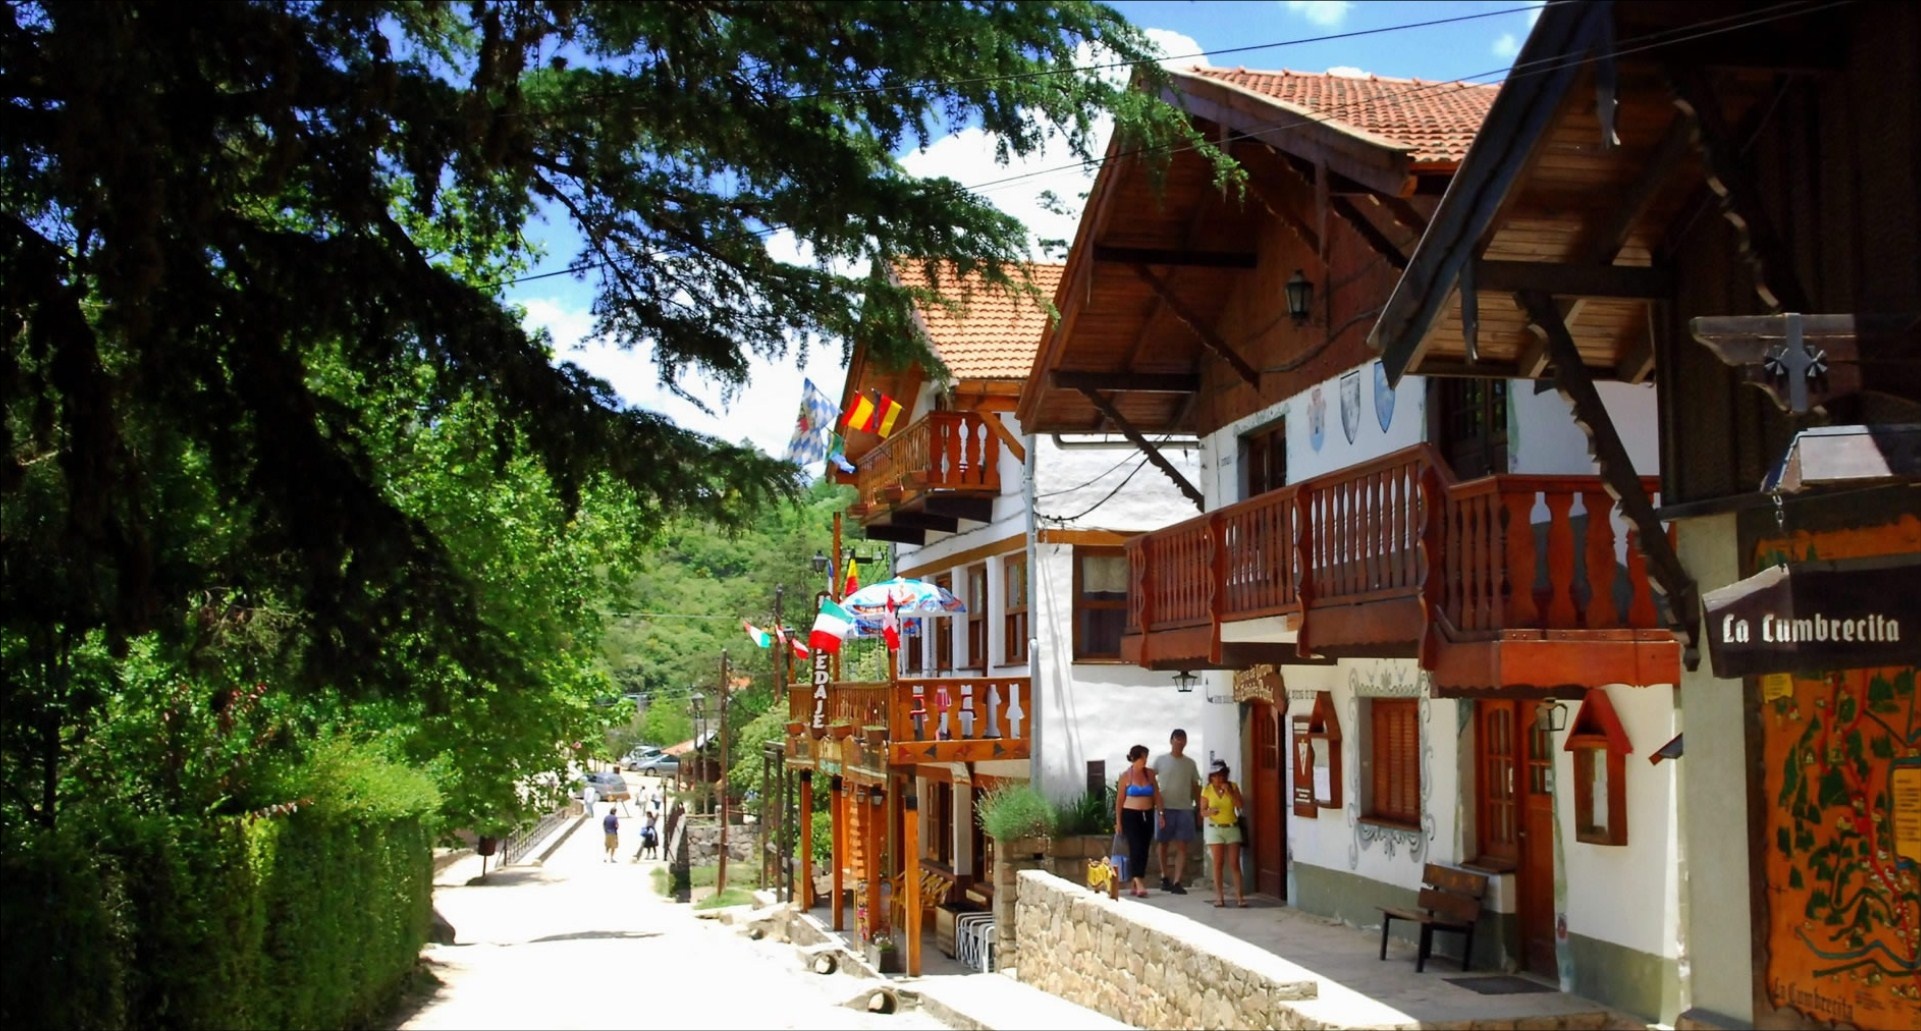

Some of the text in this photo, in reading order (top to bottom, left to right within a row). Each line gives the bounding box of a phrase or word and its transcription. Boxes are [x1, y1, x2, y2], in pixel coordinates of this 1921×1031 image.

[813, 595, 831, 729] EDAJE
[1722, 613, 1900, 643] La Cumbrecita
